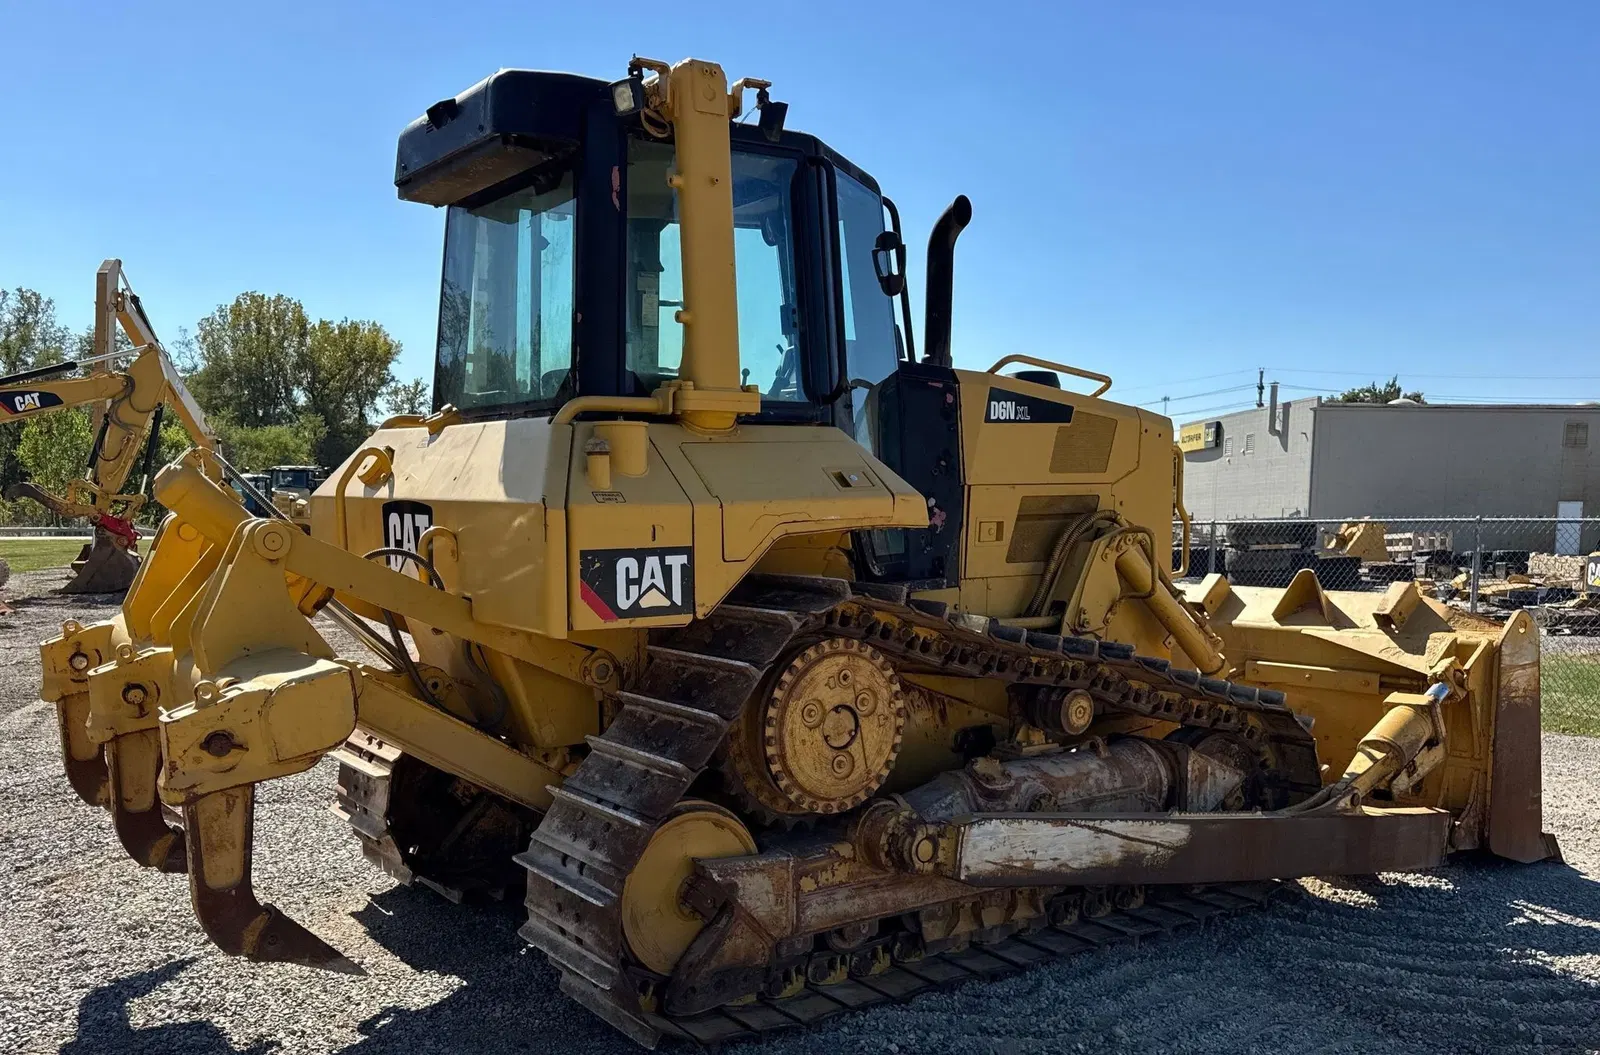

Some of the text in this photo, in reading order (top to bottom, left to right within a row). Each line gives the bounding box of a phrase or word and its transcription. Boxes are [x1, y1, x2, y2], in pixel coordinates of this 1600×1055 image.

[14, 392, 41, 412] CAT
[990, 400, 1031, 420] D6N XL
[616, 555, 689, 610] CAT
